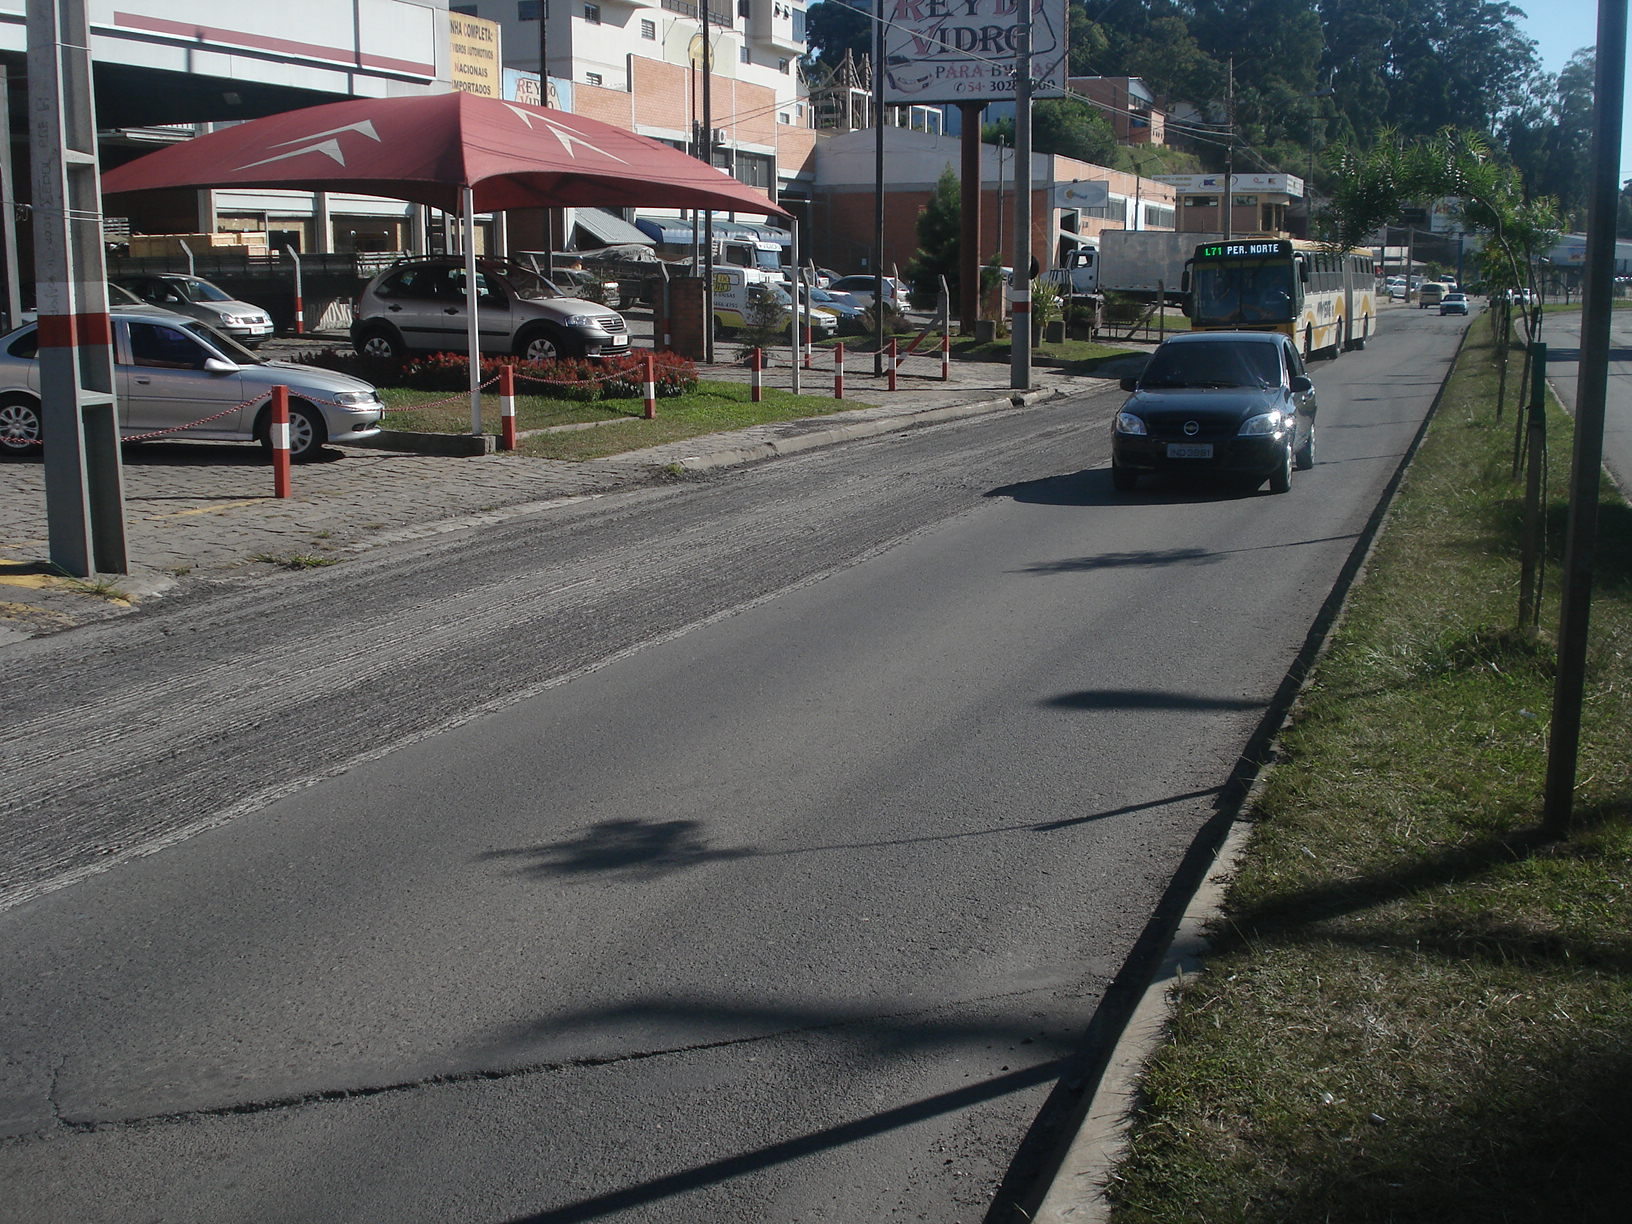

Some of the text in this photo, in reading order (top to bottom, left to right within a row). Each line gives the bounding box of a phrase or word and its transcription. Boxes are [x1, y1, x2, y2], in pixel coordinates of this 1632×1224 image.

[454, 62, 488, 78] NACIONAIS
[451, 80, 491, 95] IMPORTADOS
[1205, 243, 1279, 256] L71 PER. NORTE
